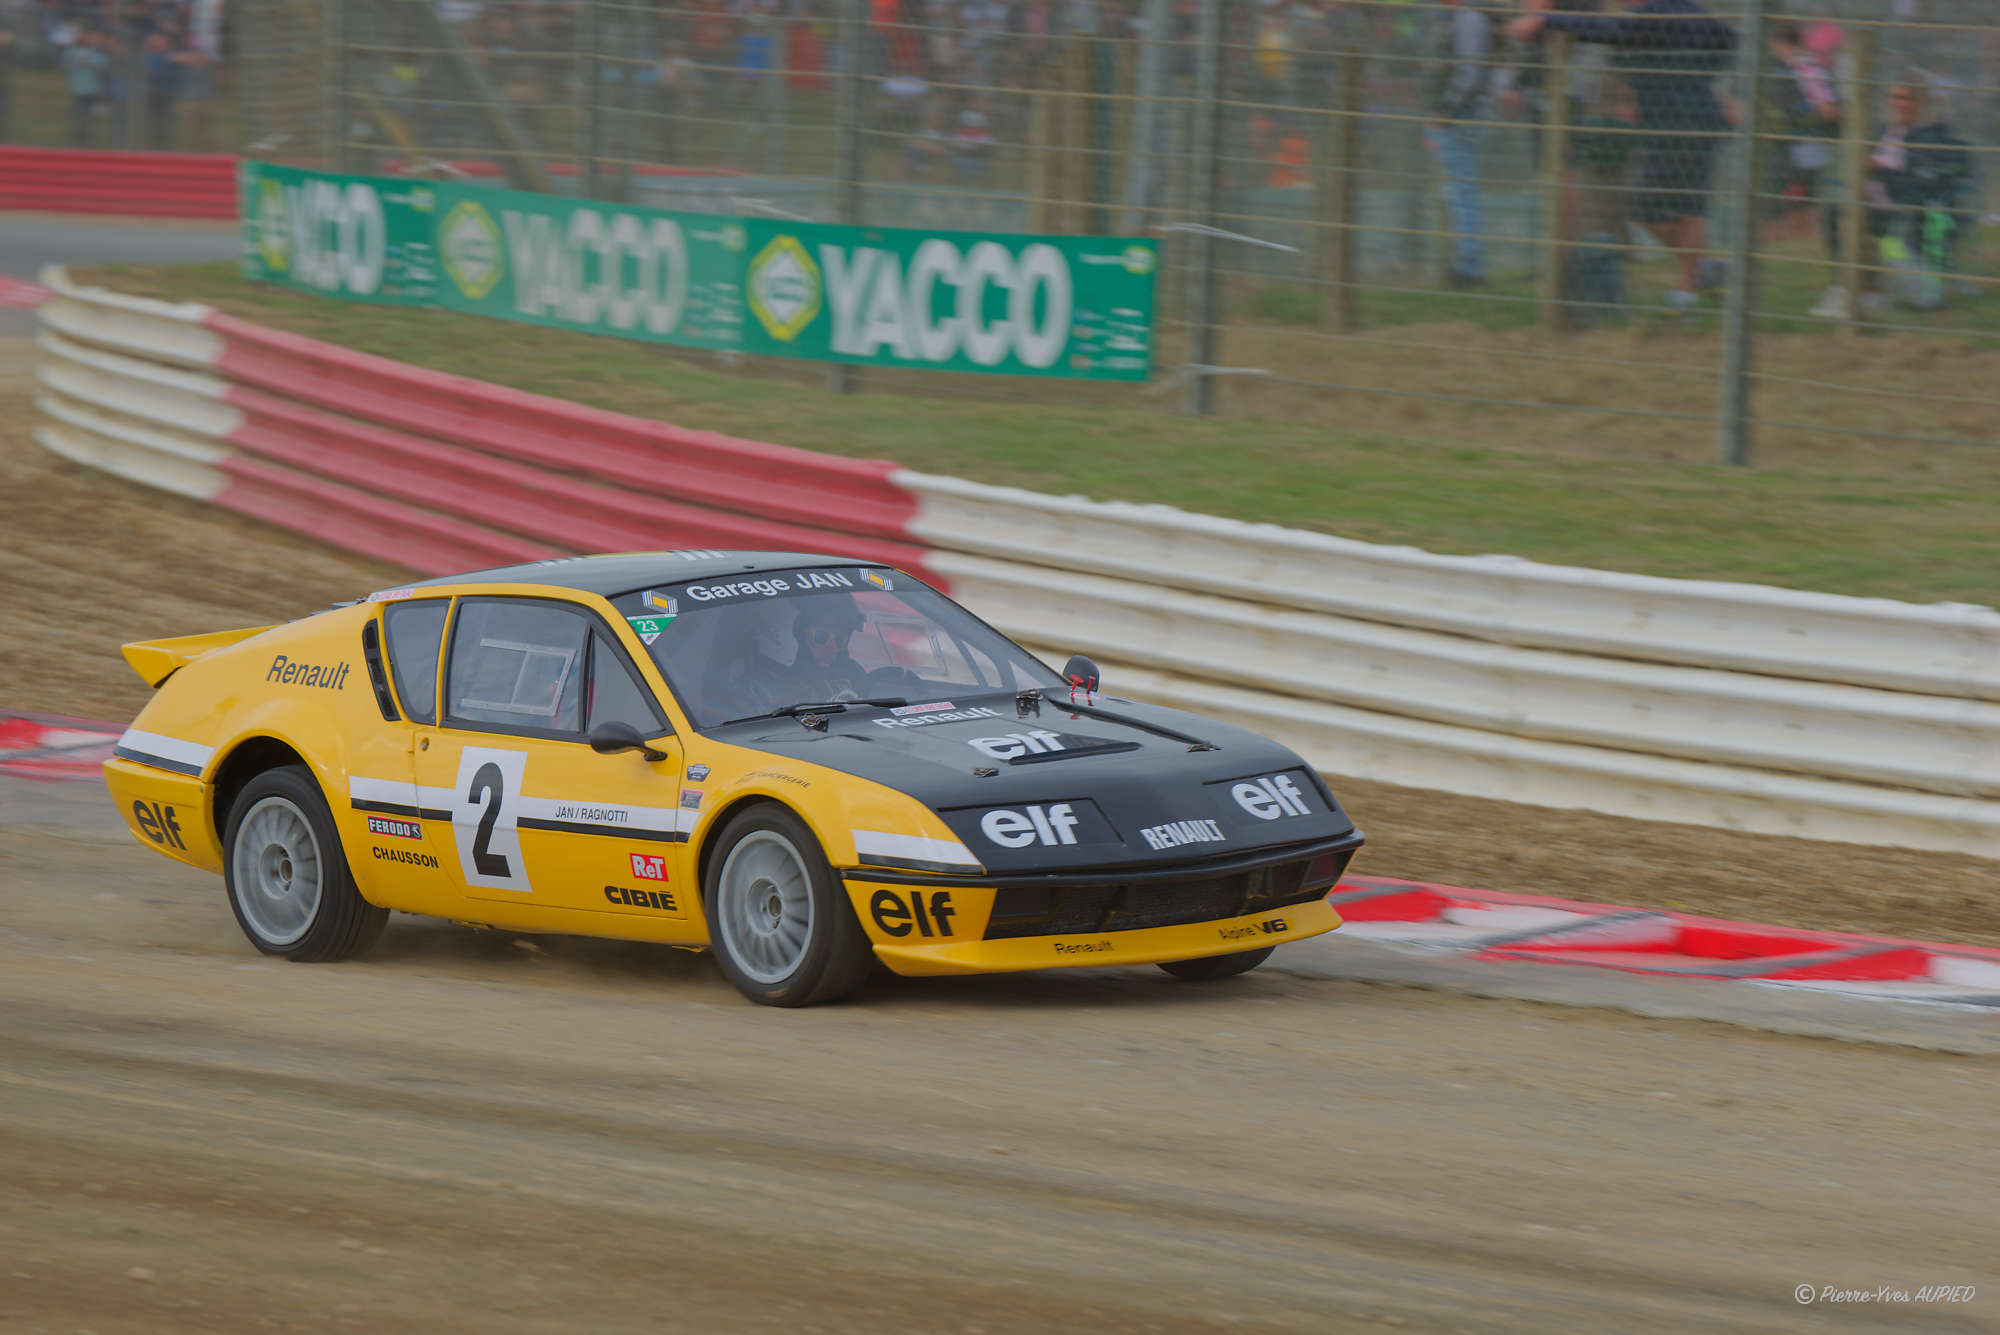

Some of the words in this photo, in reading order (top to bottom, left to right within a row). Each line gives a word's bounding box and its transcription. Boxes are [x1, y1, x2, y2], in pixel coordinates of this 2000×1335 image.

[501, 207, 689, 335] YACCO
[818, 239, 1073, 368] YACCO
[686, 579, 790, 600] Garage
[796, 572, 853, 589] JAN
[636, 620, 659, 632] 23
[266, 655, 350, 690] Renault
[872, 706, 1003, 729] Renault
[967, 730, 1065, 760] elf
[1231, 774, 1312, 821] elf
[133, 800, 188, 851] elf
[368, 819, 411, 836] FERODO
[467, 762, 512, 878] 2
[581, 807, 629, 823] RAGNOTTI
[981, 804, 1078, 848] elf
[1140, 819, 1226, 850] RENAULT
[372, 846, 440, 869] CHAUSSON
[631, 855, 665, 879] ReT
[870, 889, 956, 938] elf
[1053, 940, 1115, 955] Renault
